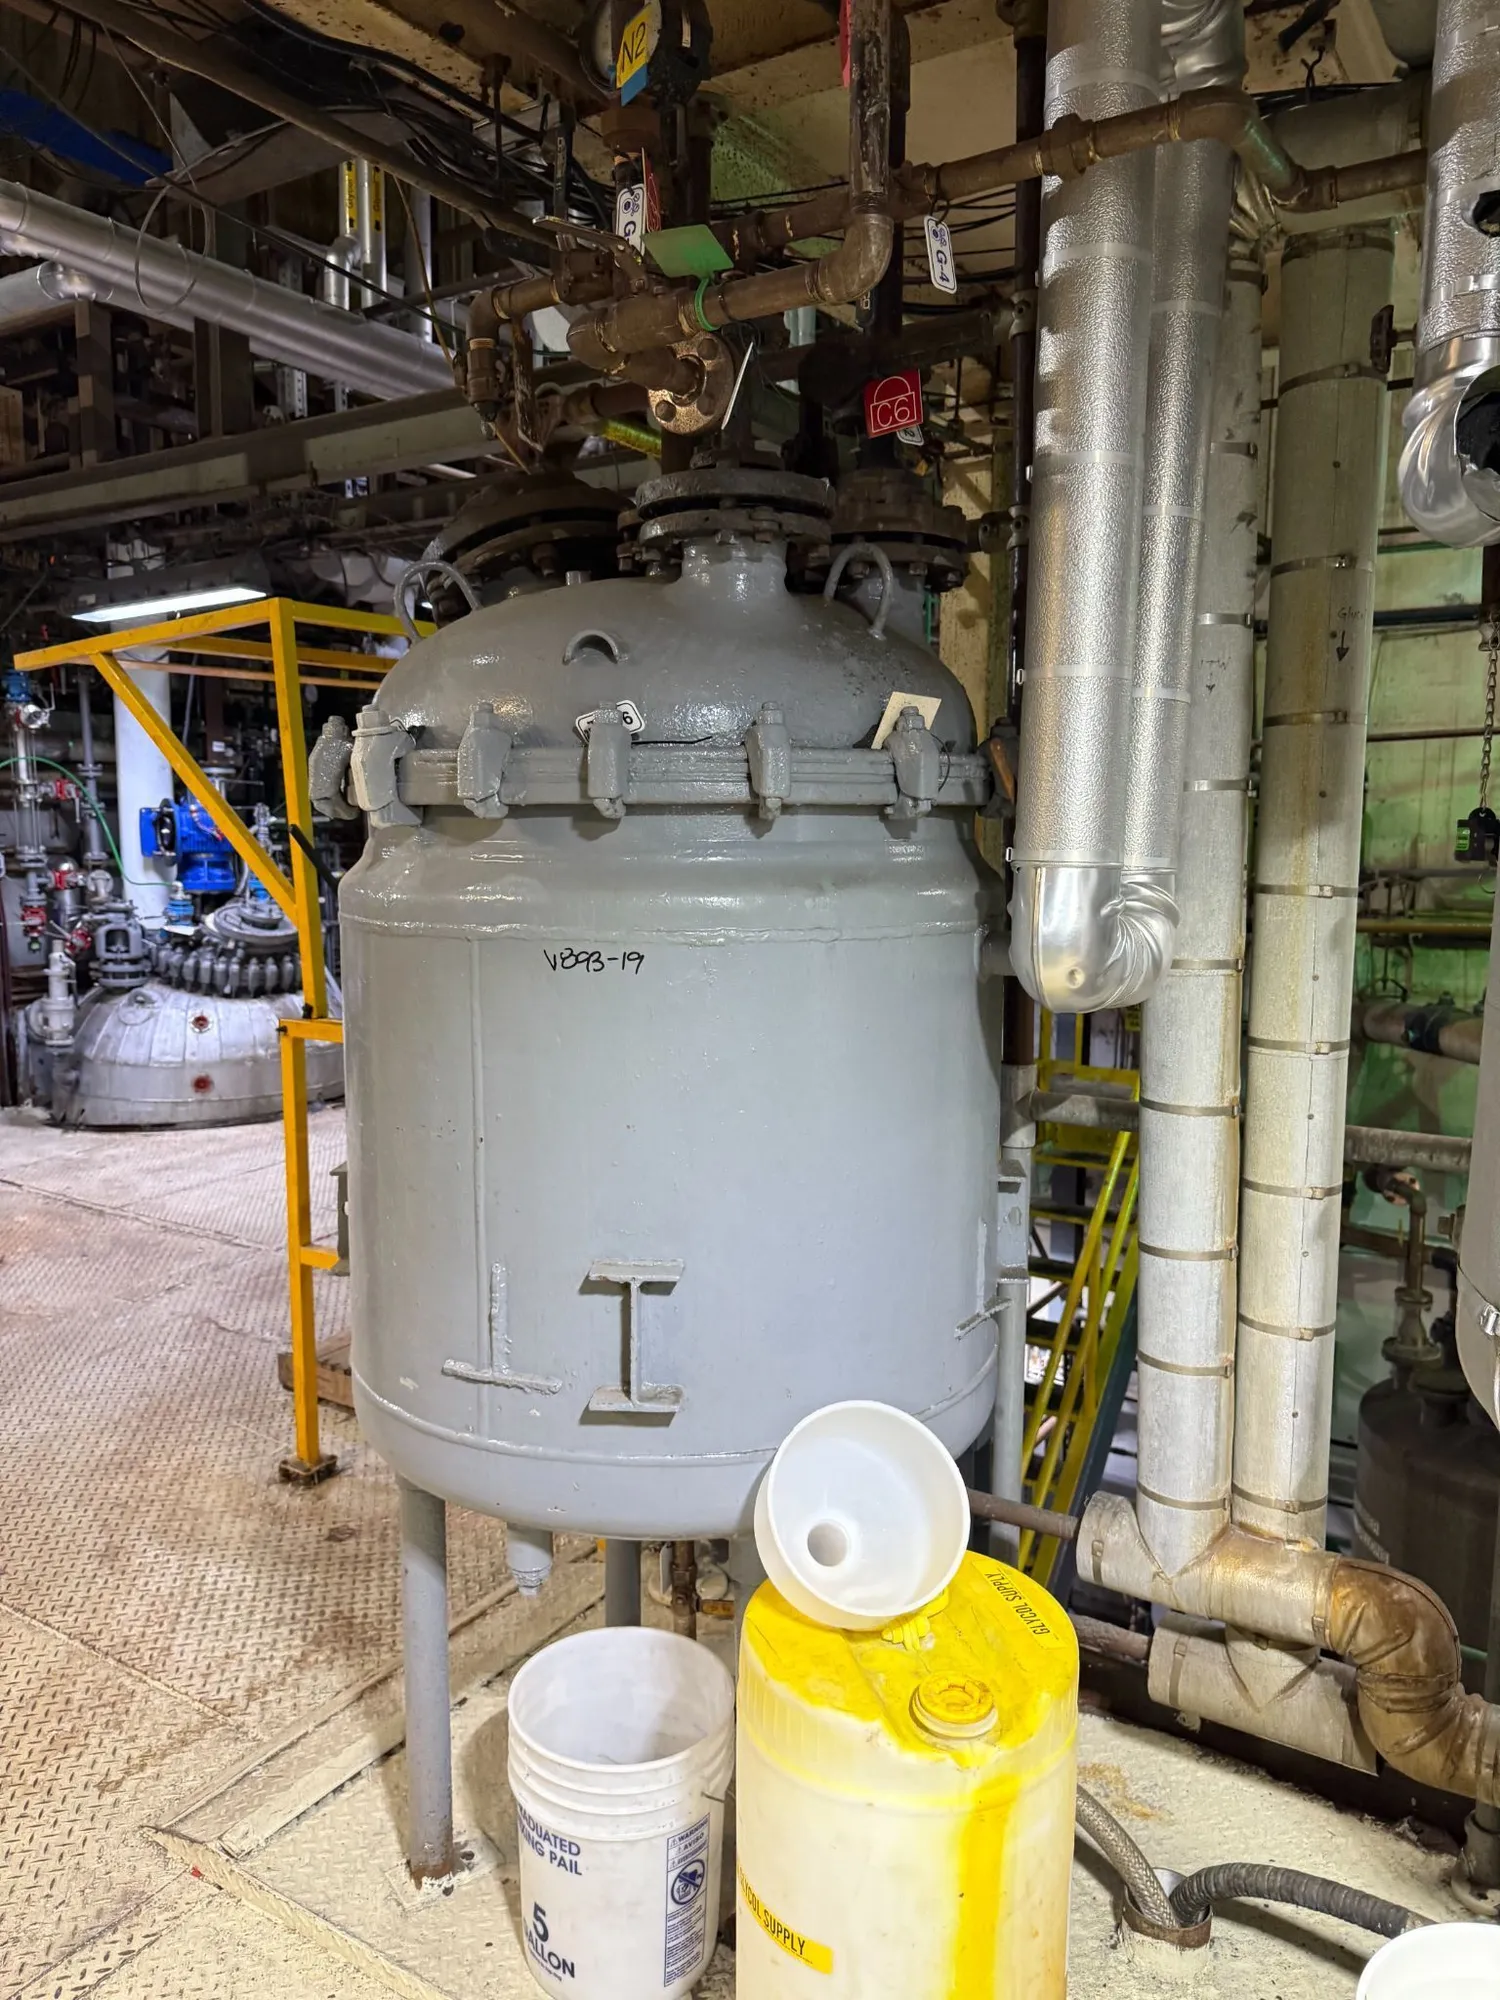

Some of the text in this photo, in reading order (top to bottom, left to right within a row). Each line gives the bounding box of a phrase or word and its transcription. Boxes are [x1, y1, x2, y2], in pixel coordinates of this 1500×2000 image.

[621, 22, 646, 73] N2
[936, 249, 950, 283] G-4
[876, 396, 910, 428] C6
[543, 947, 645, 975] V893-19
[984, 1572, 1022, 1602] SUPPLY
[1012, 1602, 1051, 1635] GLYCOL
[549, 1850, 583, 1876] PAIL
[532, 1901, 550, 1943] 5
[763, 1908, 806, 1956] SUPPLY
